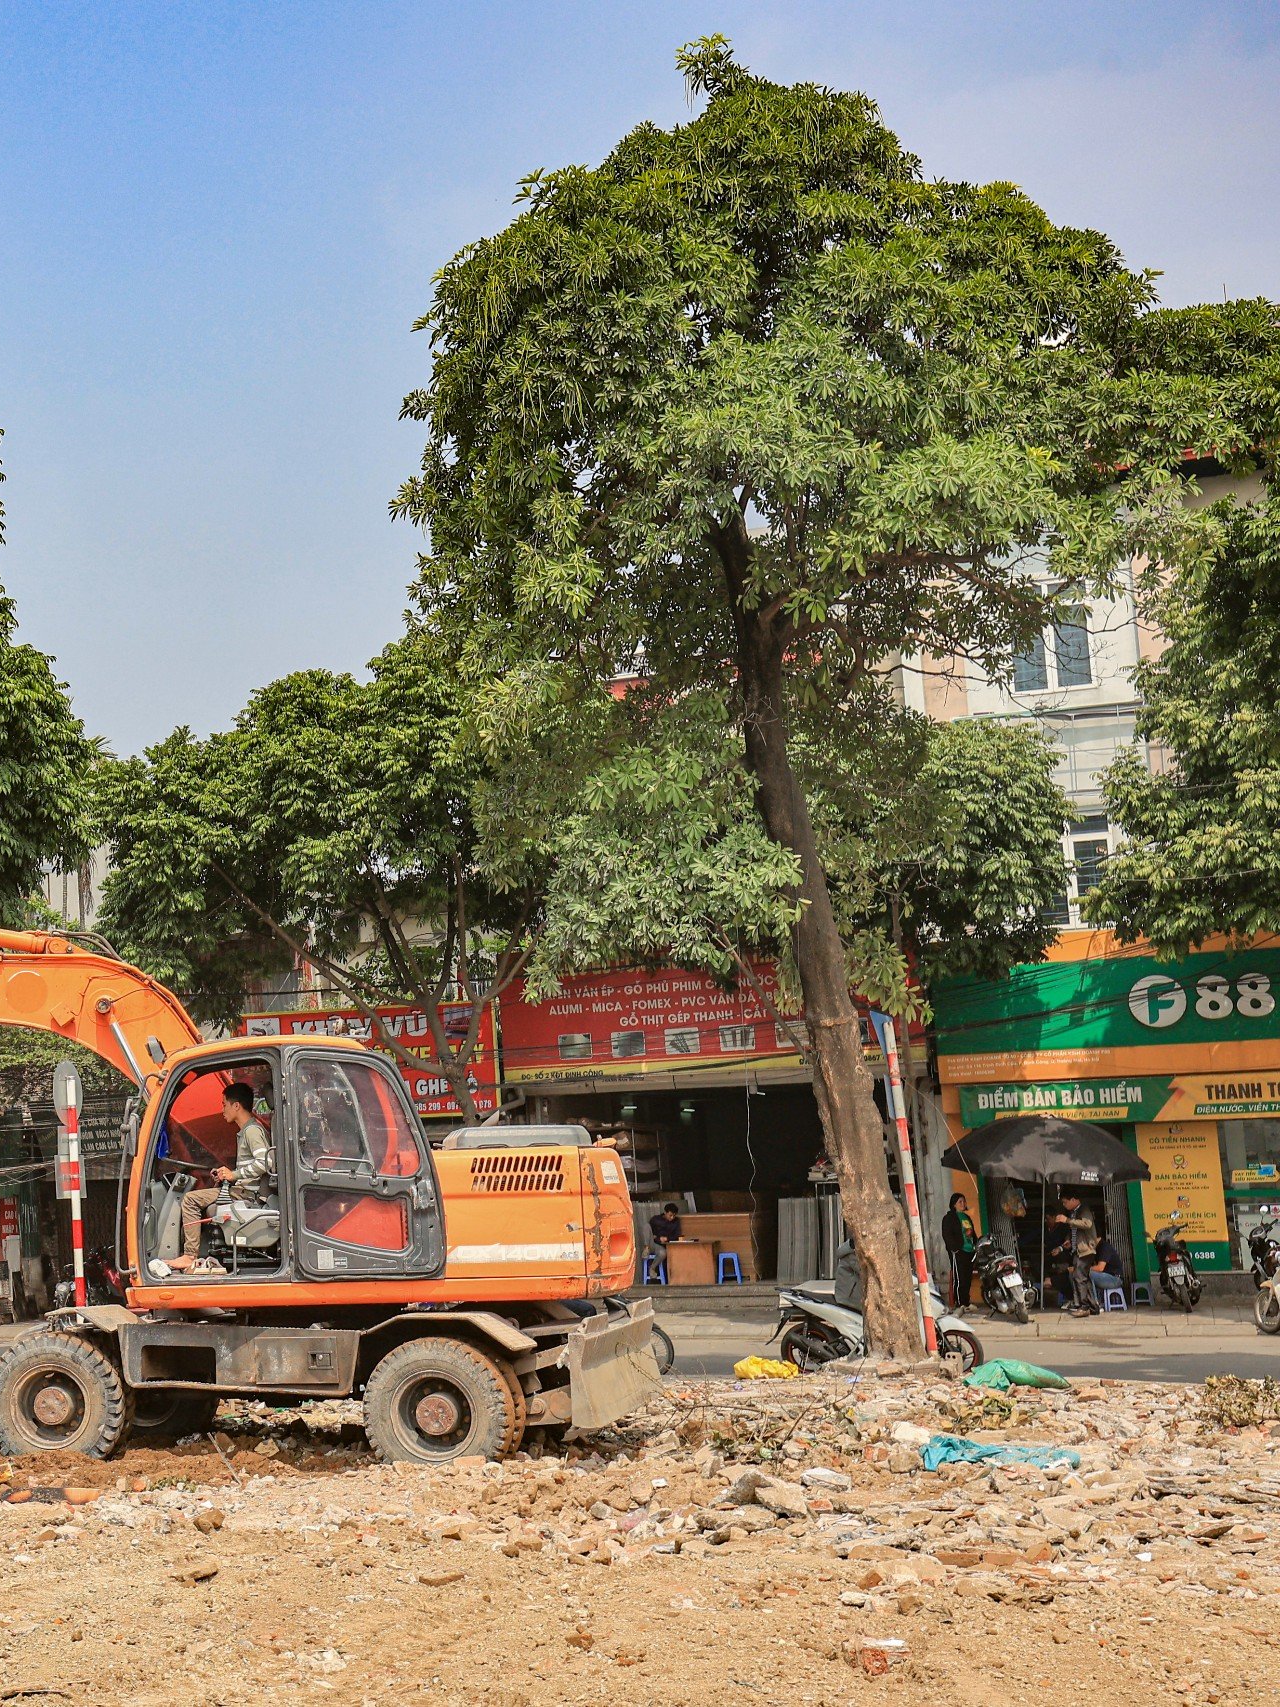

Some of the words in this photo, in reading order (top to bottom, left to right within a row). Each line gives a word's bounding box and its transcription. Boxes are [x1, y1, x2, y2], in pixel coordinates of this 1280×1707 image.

[624, 981, 643, 995] GỖ
[646, 979, 669, 994] PHỦ
[672, 980, 701, 993] PHIM
[549, 1004, 583, 1016] ALUMI
[593, 1002, 622, 1013] MICA
[632, 998, 671, 1011] FOMEX
[682, 996, 706, 1008] PVC
[390, 1011, 428, 1037] VŨ
[620, 1013, 639, 1027] GỖ
[641, 1014, 664, 1028] THỊT
[667, 1011, 691, 1024] GÉP
[694, 1009, 734, 1023] THANH
[583, 1069, 604, 1078] CÔNG
[978, 1086, 1019, 1109] ĐIỂM
[1024, 1087, 1056, 1107] BÁN
[1061, 1084, 1095, 1105] BẢO
[1099, 1081, 1143, 1104] HIỂM
[1205, 1083, 1263, 1100] THANH
[1196, 1106, 1217, 1114] ĐIỆN
[1248, 1101, 1269, 1112] VIỄN
[84, 1143, 95, 1151] LAN
[95, 1142, 107, 1150] CAN
[1172, 1172, 1187, 1180] BẢO
[1189, 1171, 1208, 1179] HIỂM
